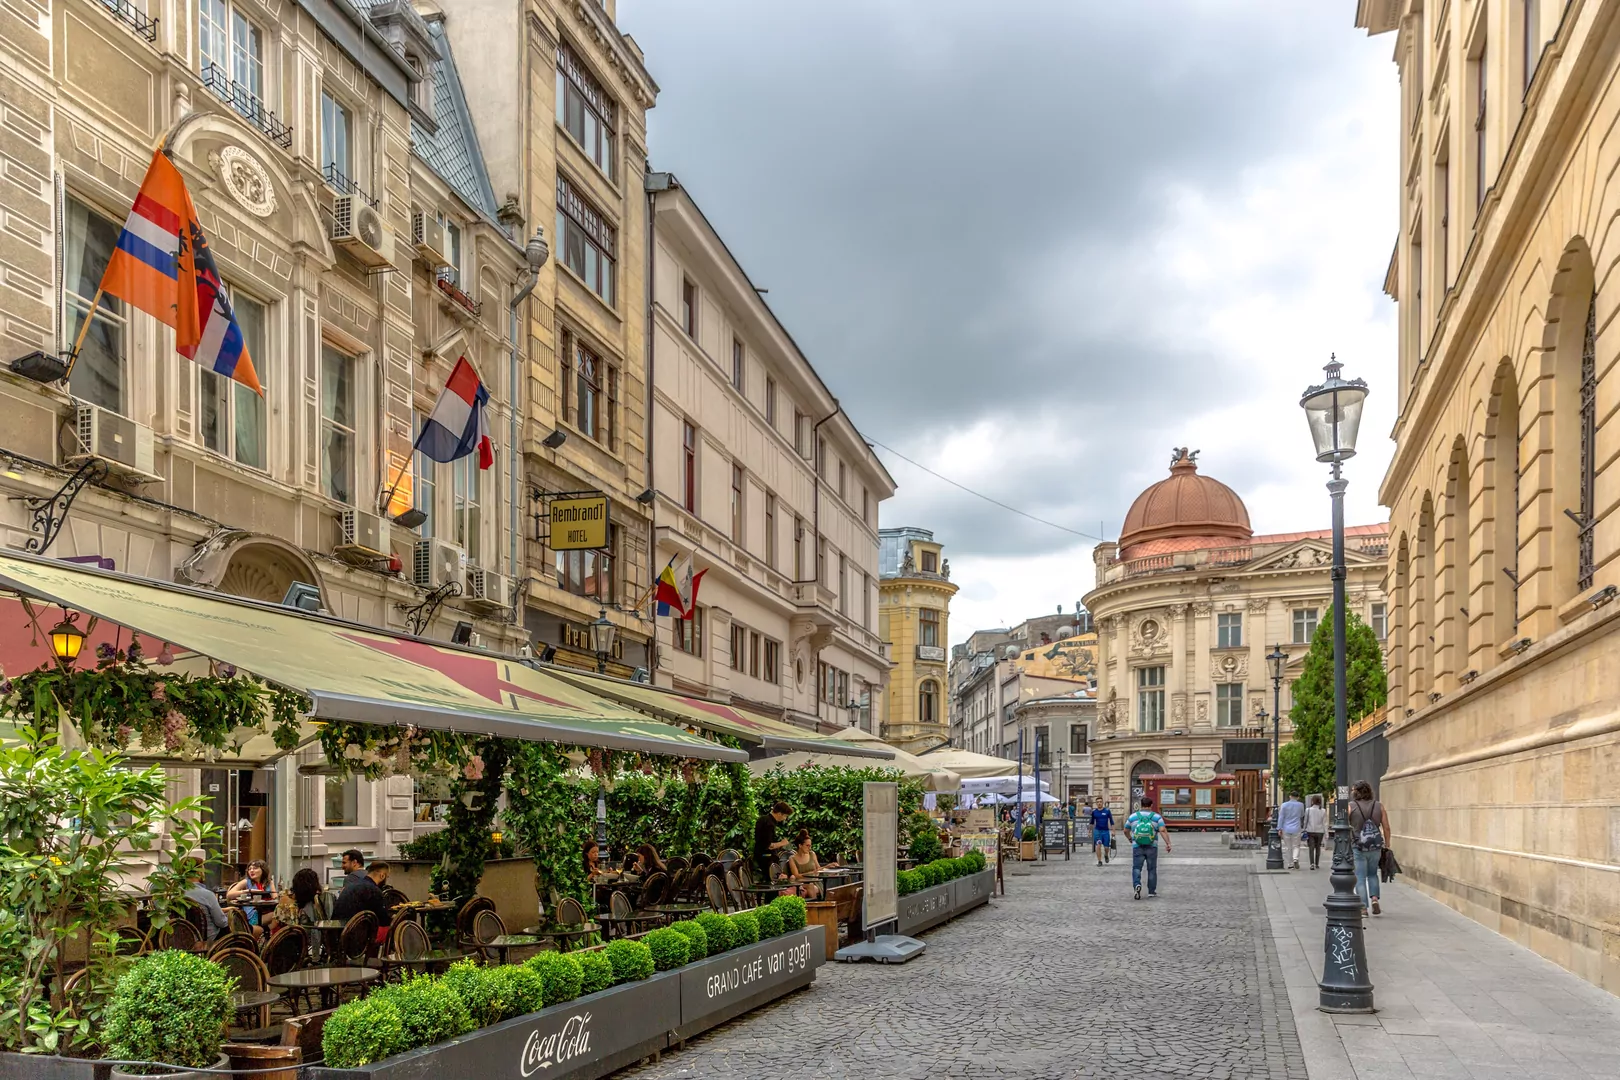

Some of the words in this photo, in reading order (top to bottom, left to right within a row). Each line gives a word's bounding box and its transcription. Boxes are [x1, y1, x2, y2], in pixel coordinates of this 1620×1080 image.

[567, 530, 588, 543] HOTEL
[706, 968, 740, 998] GRAND
[741, 954, 763, 985] CAFÉ
[767, 951, 785, 975] van
[788, 935, 811, 974] gogh
